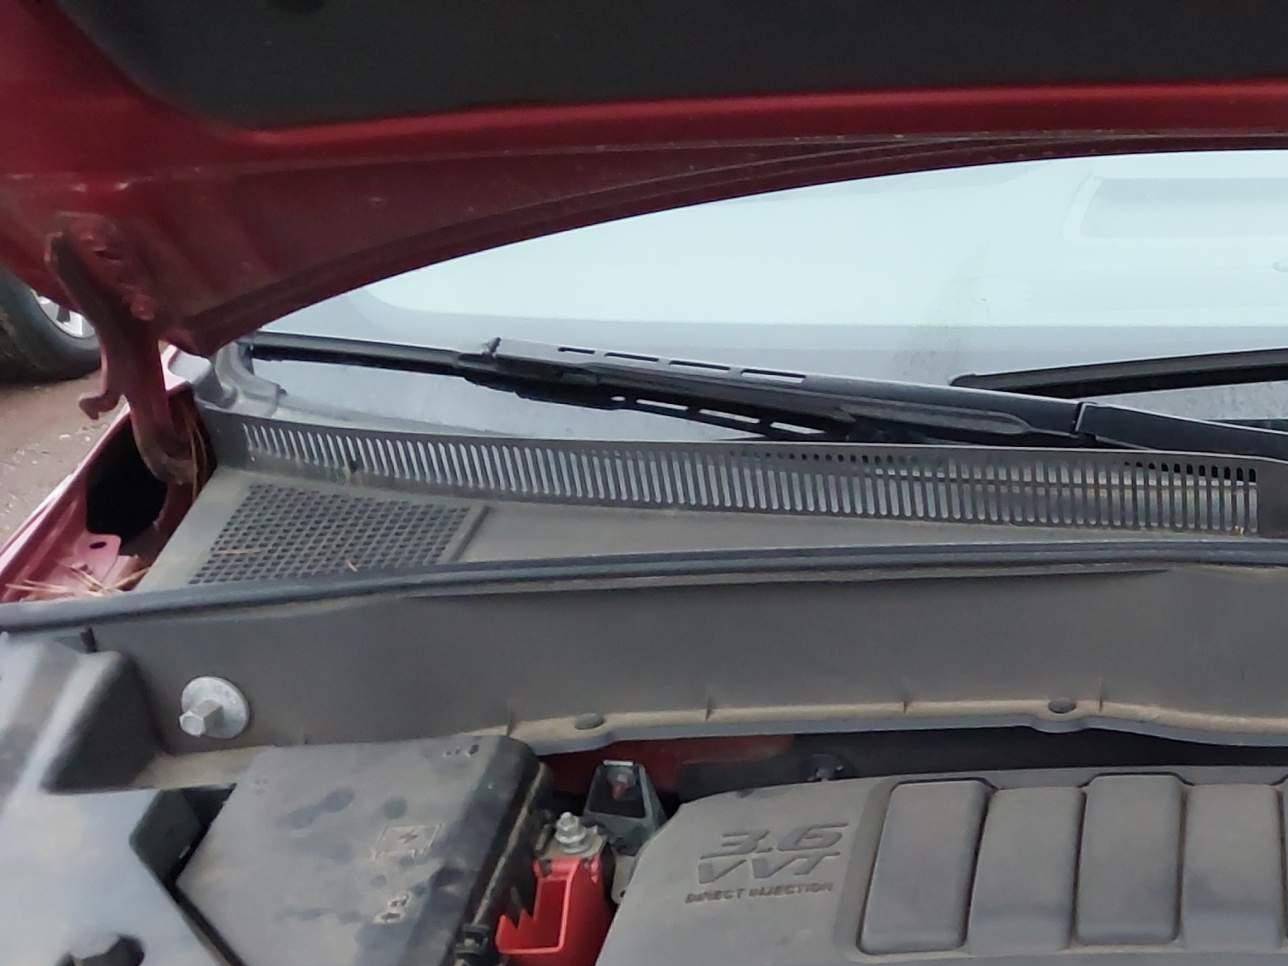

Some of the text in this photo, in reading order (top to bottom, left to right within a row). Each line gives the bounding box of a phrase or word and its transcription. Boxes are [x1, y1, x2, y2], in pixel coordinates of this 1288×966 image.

[700, 822, 849, 860] 3.6
[698, 852, 841, 885] VVT
[685, 881, 834, 904] DIRECT INJECTION
